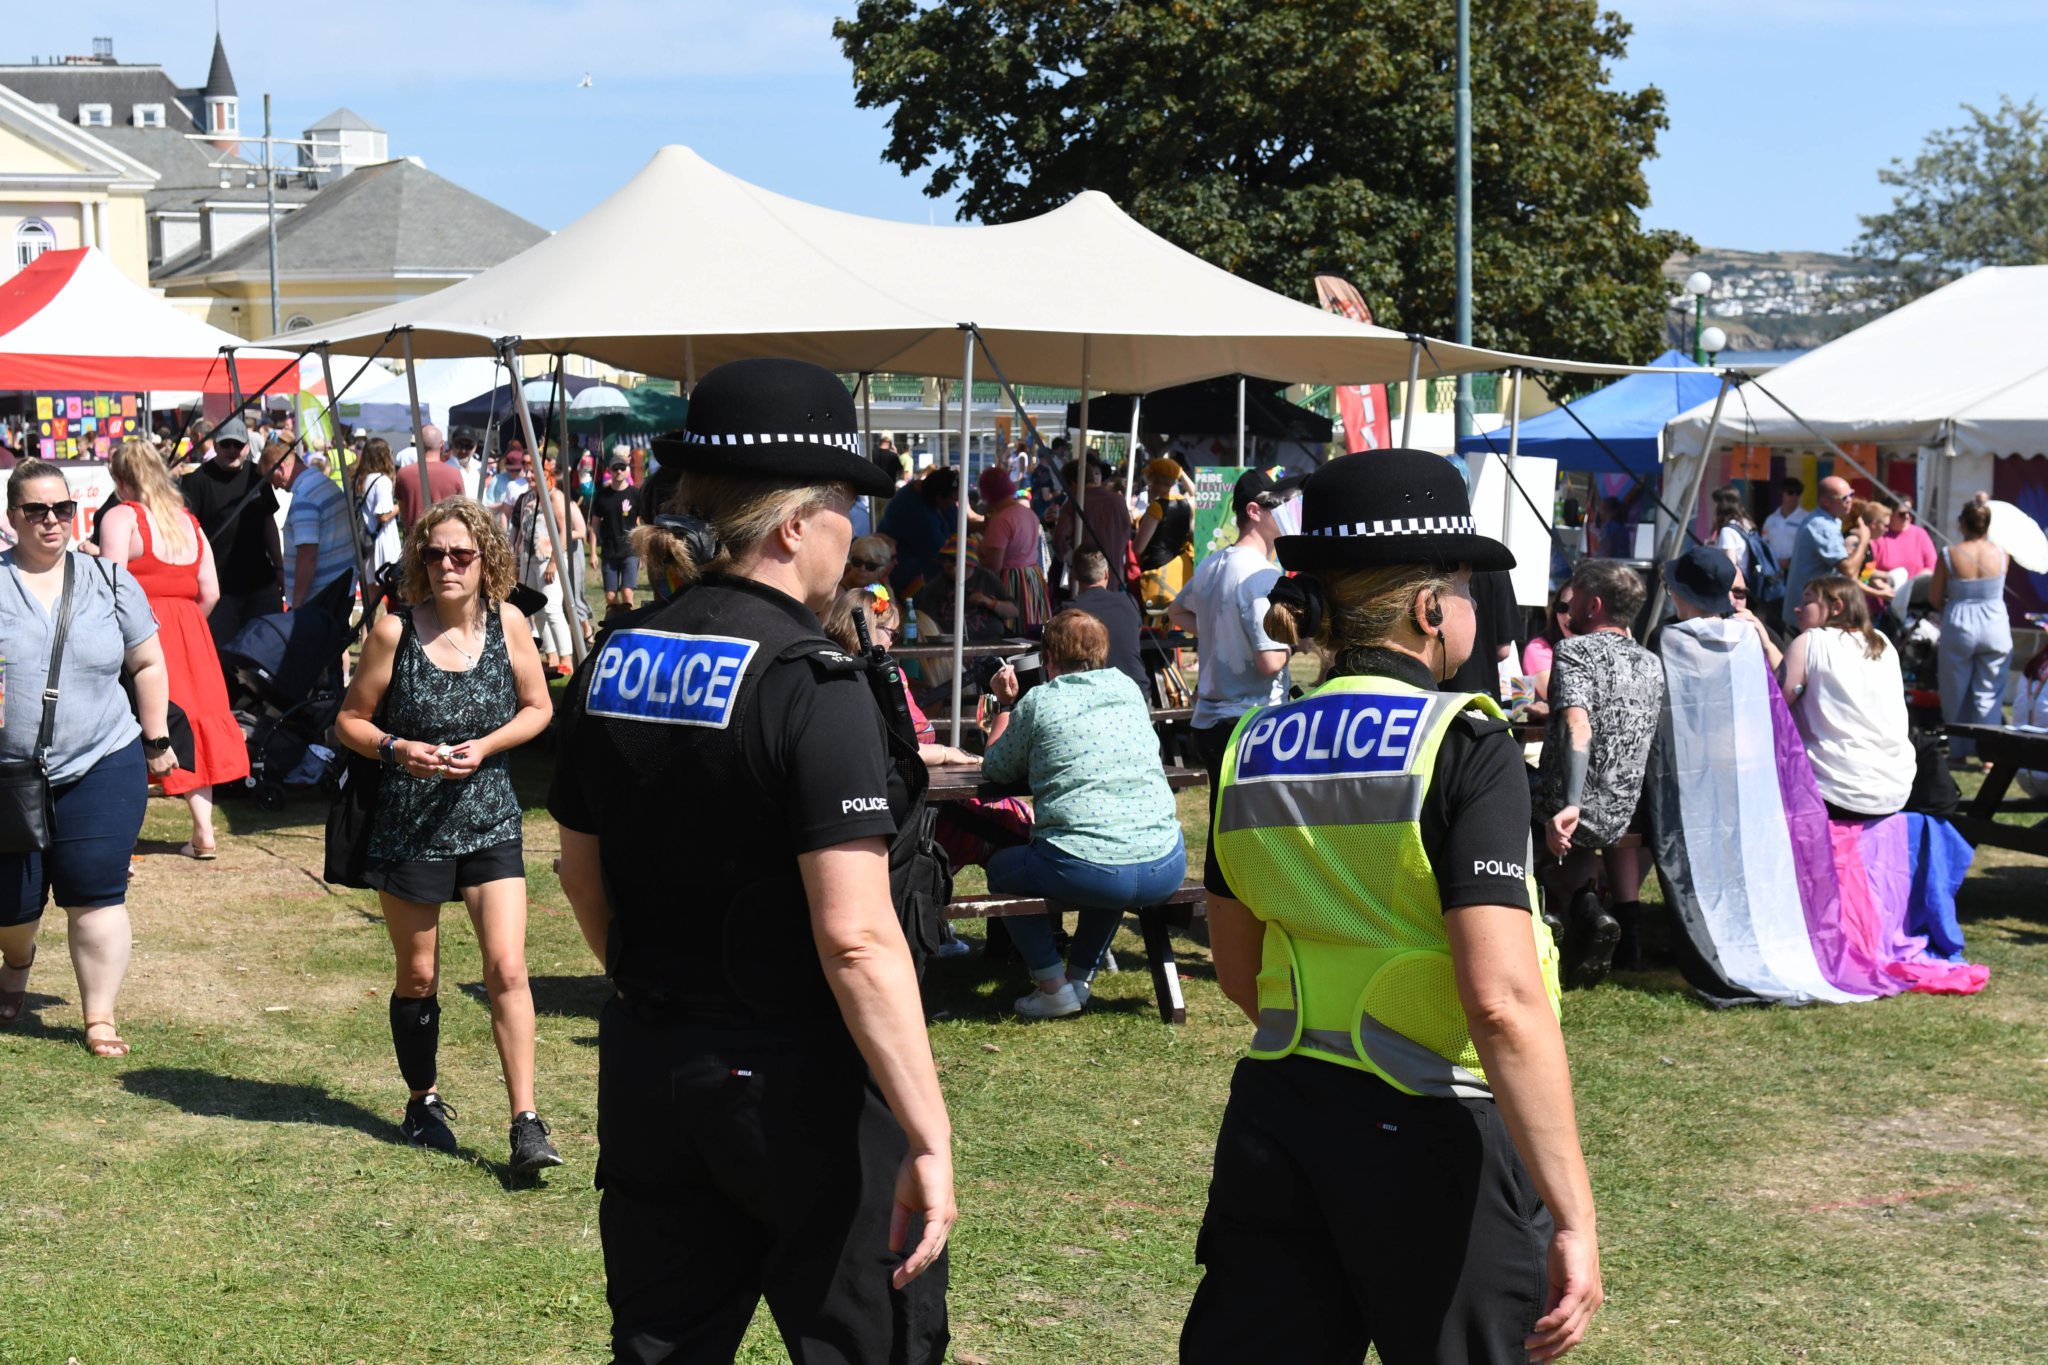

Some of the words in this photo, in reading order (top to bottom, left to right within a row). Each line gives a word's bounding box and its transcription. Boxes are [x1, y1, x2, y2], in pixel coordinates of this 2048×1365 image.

[1195, 473, 1223, 483] PRIDE
[1195, 482, 1236, 492] FESTIVA
[1195, 492, 1222, 502] 2022
[592, 647, 740, 709] POLICE
[1243, 707, 1418, 763] POLICE
[841, 796, 890, 815] POLICE
[1473, 859, 1525, 881] POLICE
